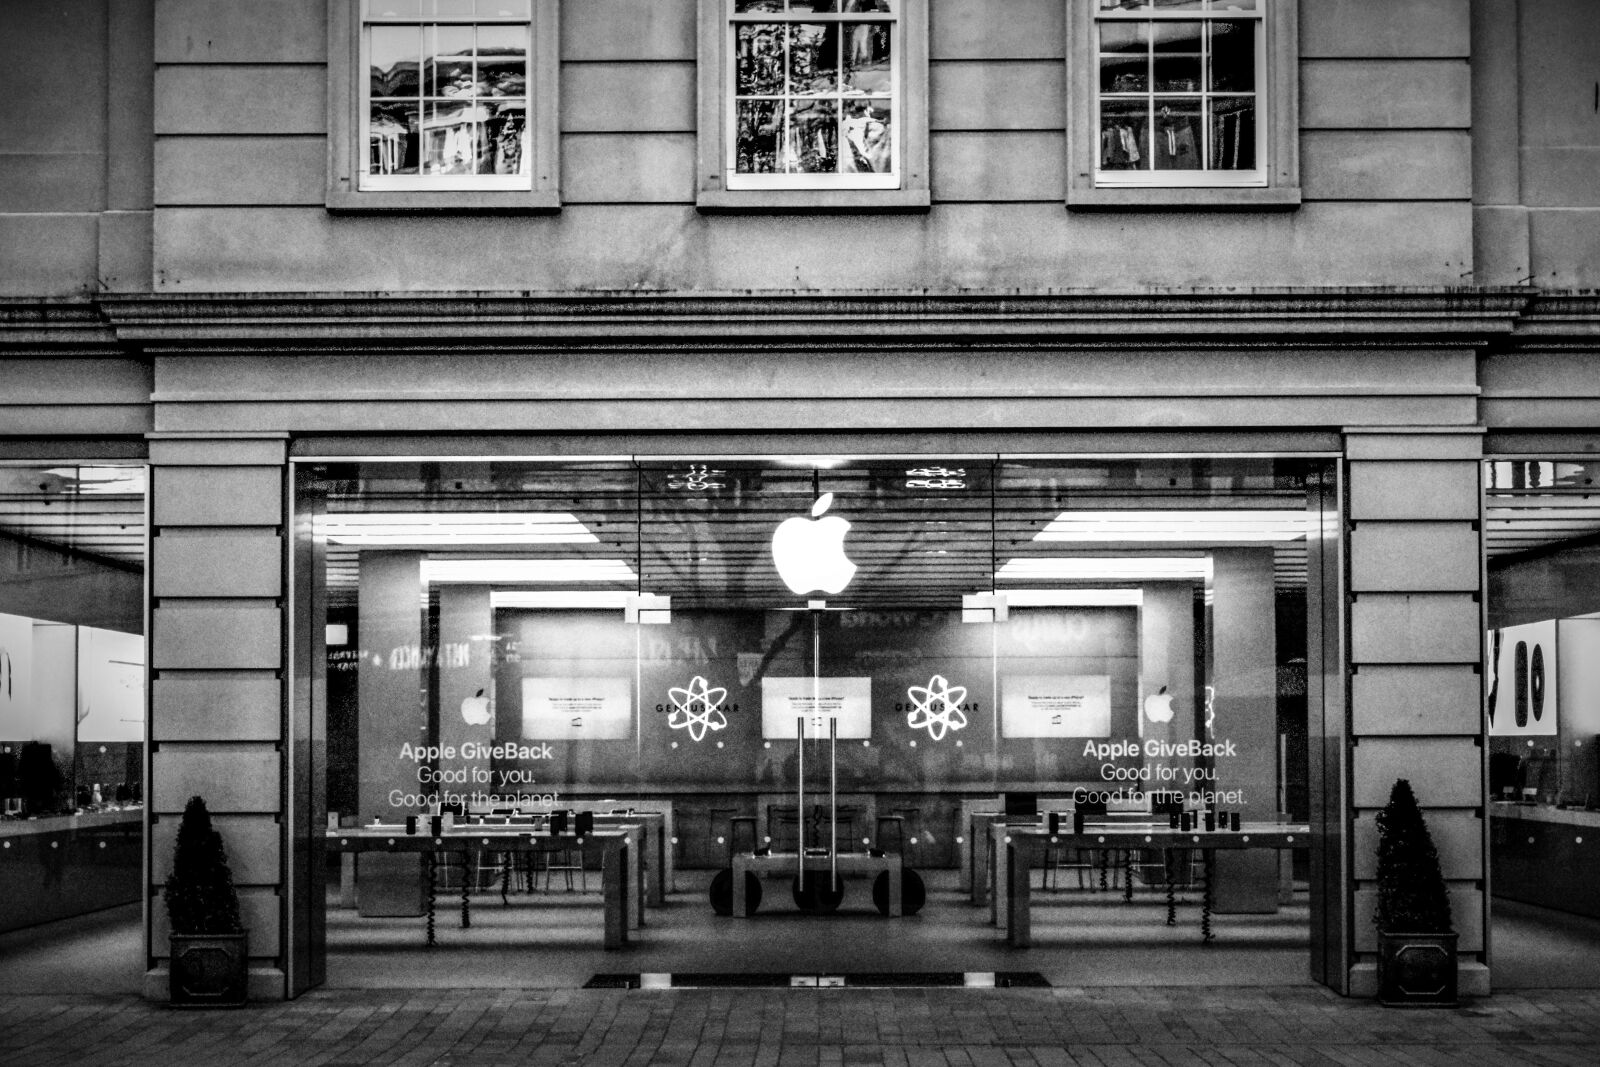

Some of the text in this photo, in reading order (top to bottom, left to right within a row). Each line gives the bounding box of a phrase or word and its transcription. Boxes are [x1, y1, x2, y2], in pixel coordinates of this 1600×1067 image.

[895, 703, 945, 712] GEUS
[400, 742, 553, 763] Apple GiveBack
[1083, 739, 1237, 760] Apple GiveBack
[417, 766, 536, 787] Good for you.
[1101, 763, 1220, 784] Good for you.
[389, 790, 563, 811] Good for the planet.
[1073, 787, 1248, 809] Good for the planet.
